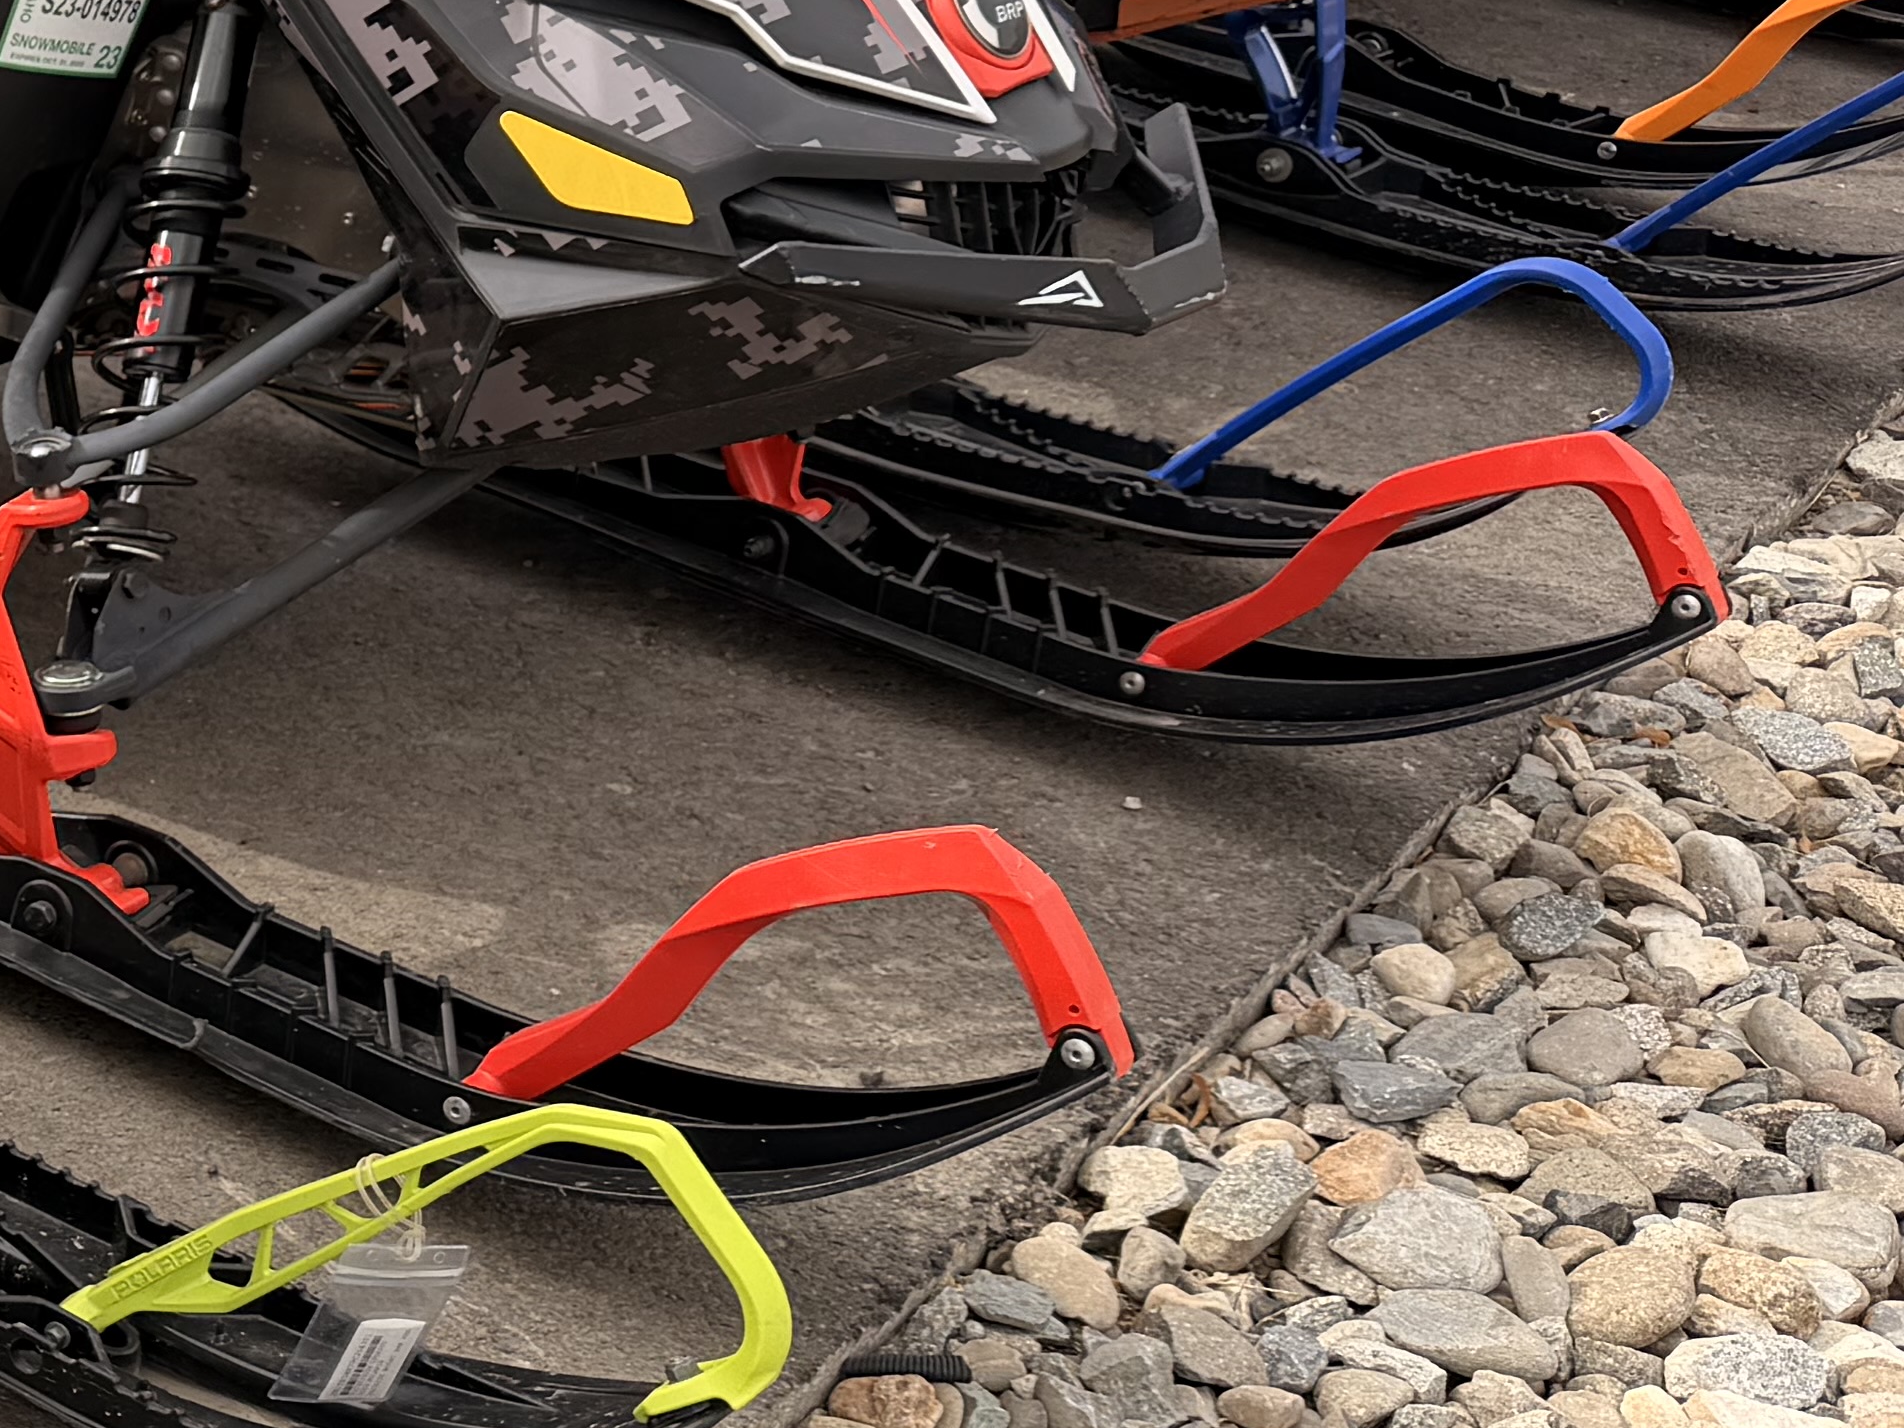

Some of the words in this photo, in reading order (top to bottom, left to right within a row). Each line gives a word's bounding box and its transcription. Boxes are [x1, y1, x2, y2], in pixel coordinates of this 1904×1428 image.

[995, 0, 1024, 23] BRP
[10, 32, 96, 56] SNOWMOBILE
[94, 45, 123, 70] 23
[111, 1233, 213, 1301] POLARIS
